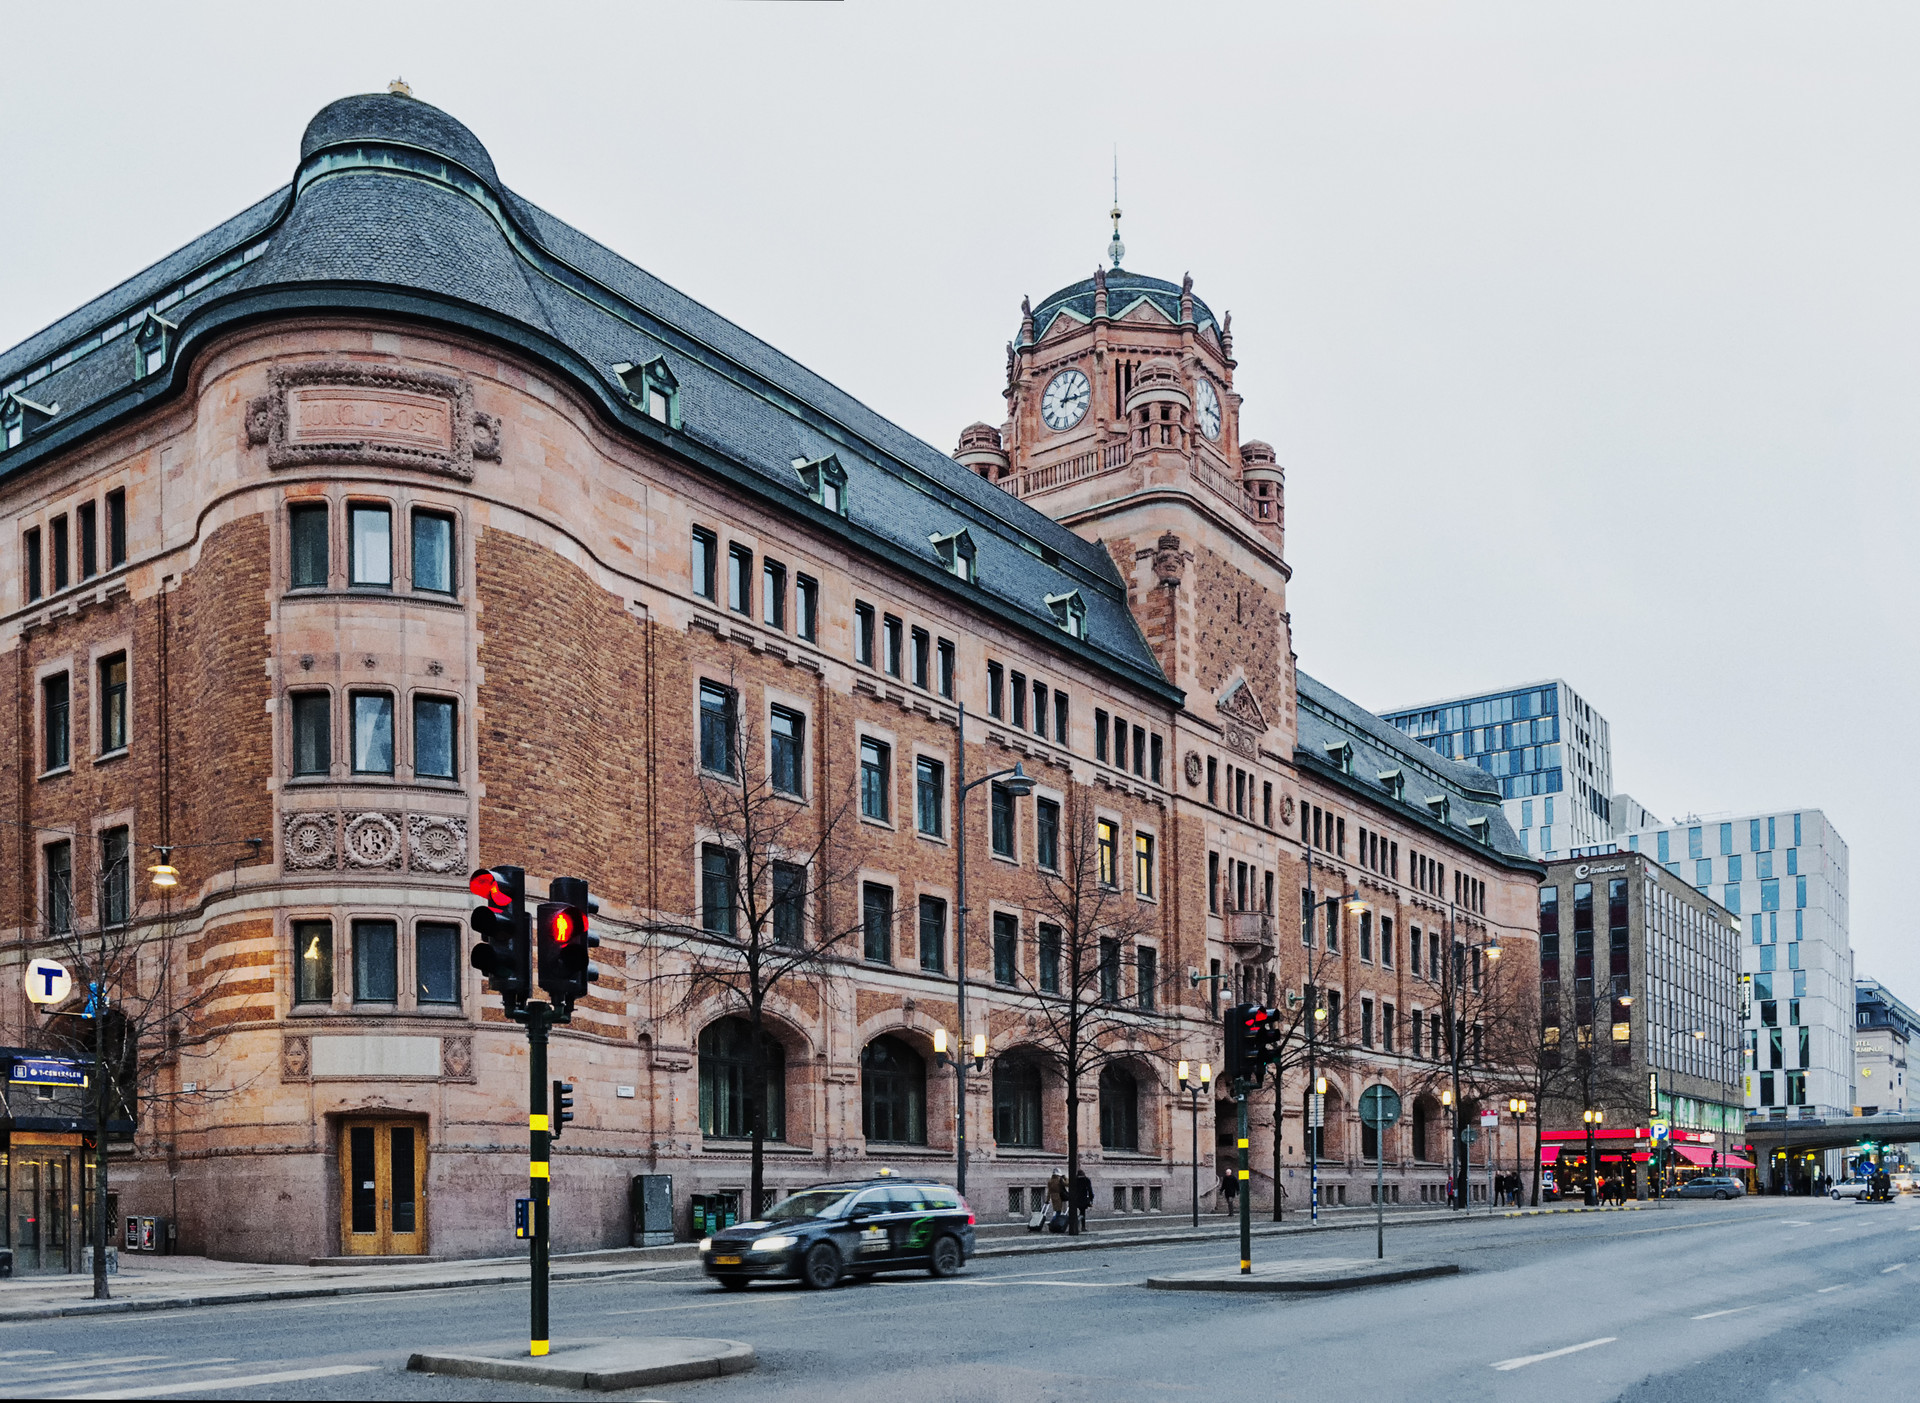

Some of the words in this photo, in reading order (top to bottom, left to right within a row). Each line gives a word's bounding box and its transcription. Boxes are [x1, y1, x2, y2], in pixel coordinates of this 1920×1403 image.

[378, 406, 448, 436] POST
[1590, 863, 1626, 875] EnterCard
[37, 966, 63, 996] T
[1653, 1124, 1667, 1140] P
